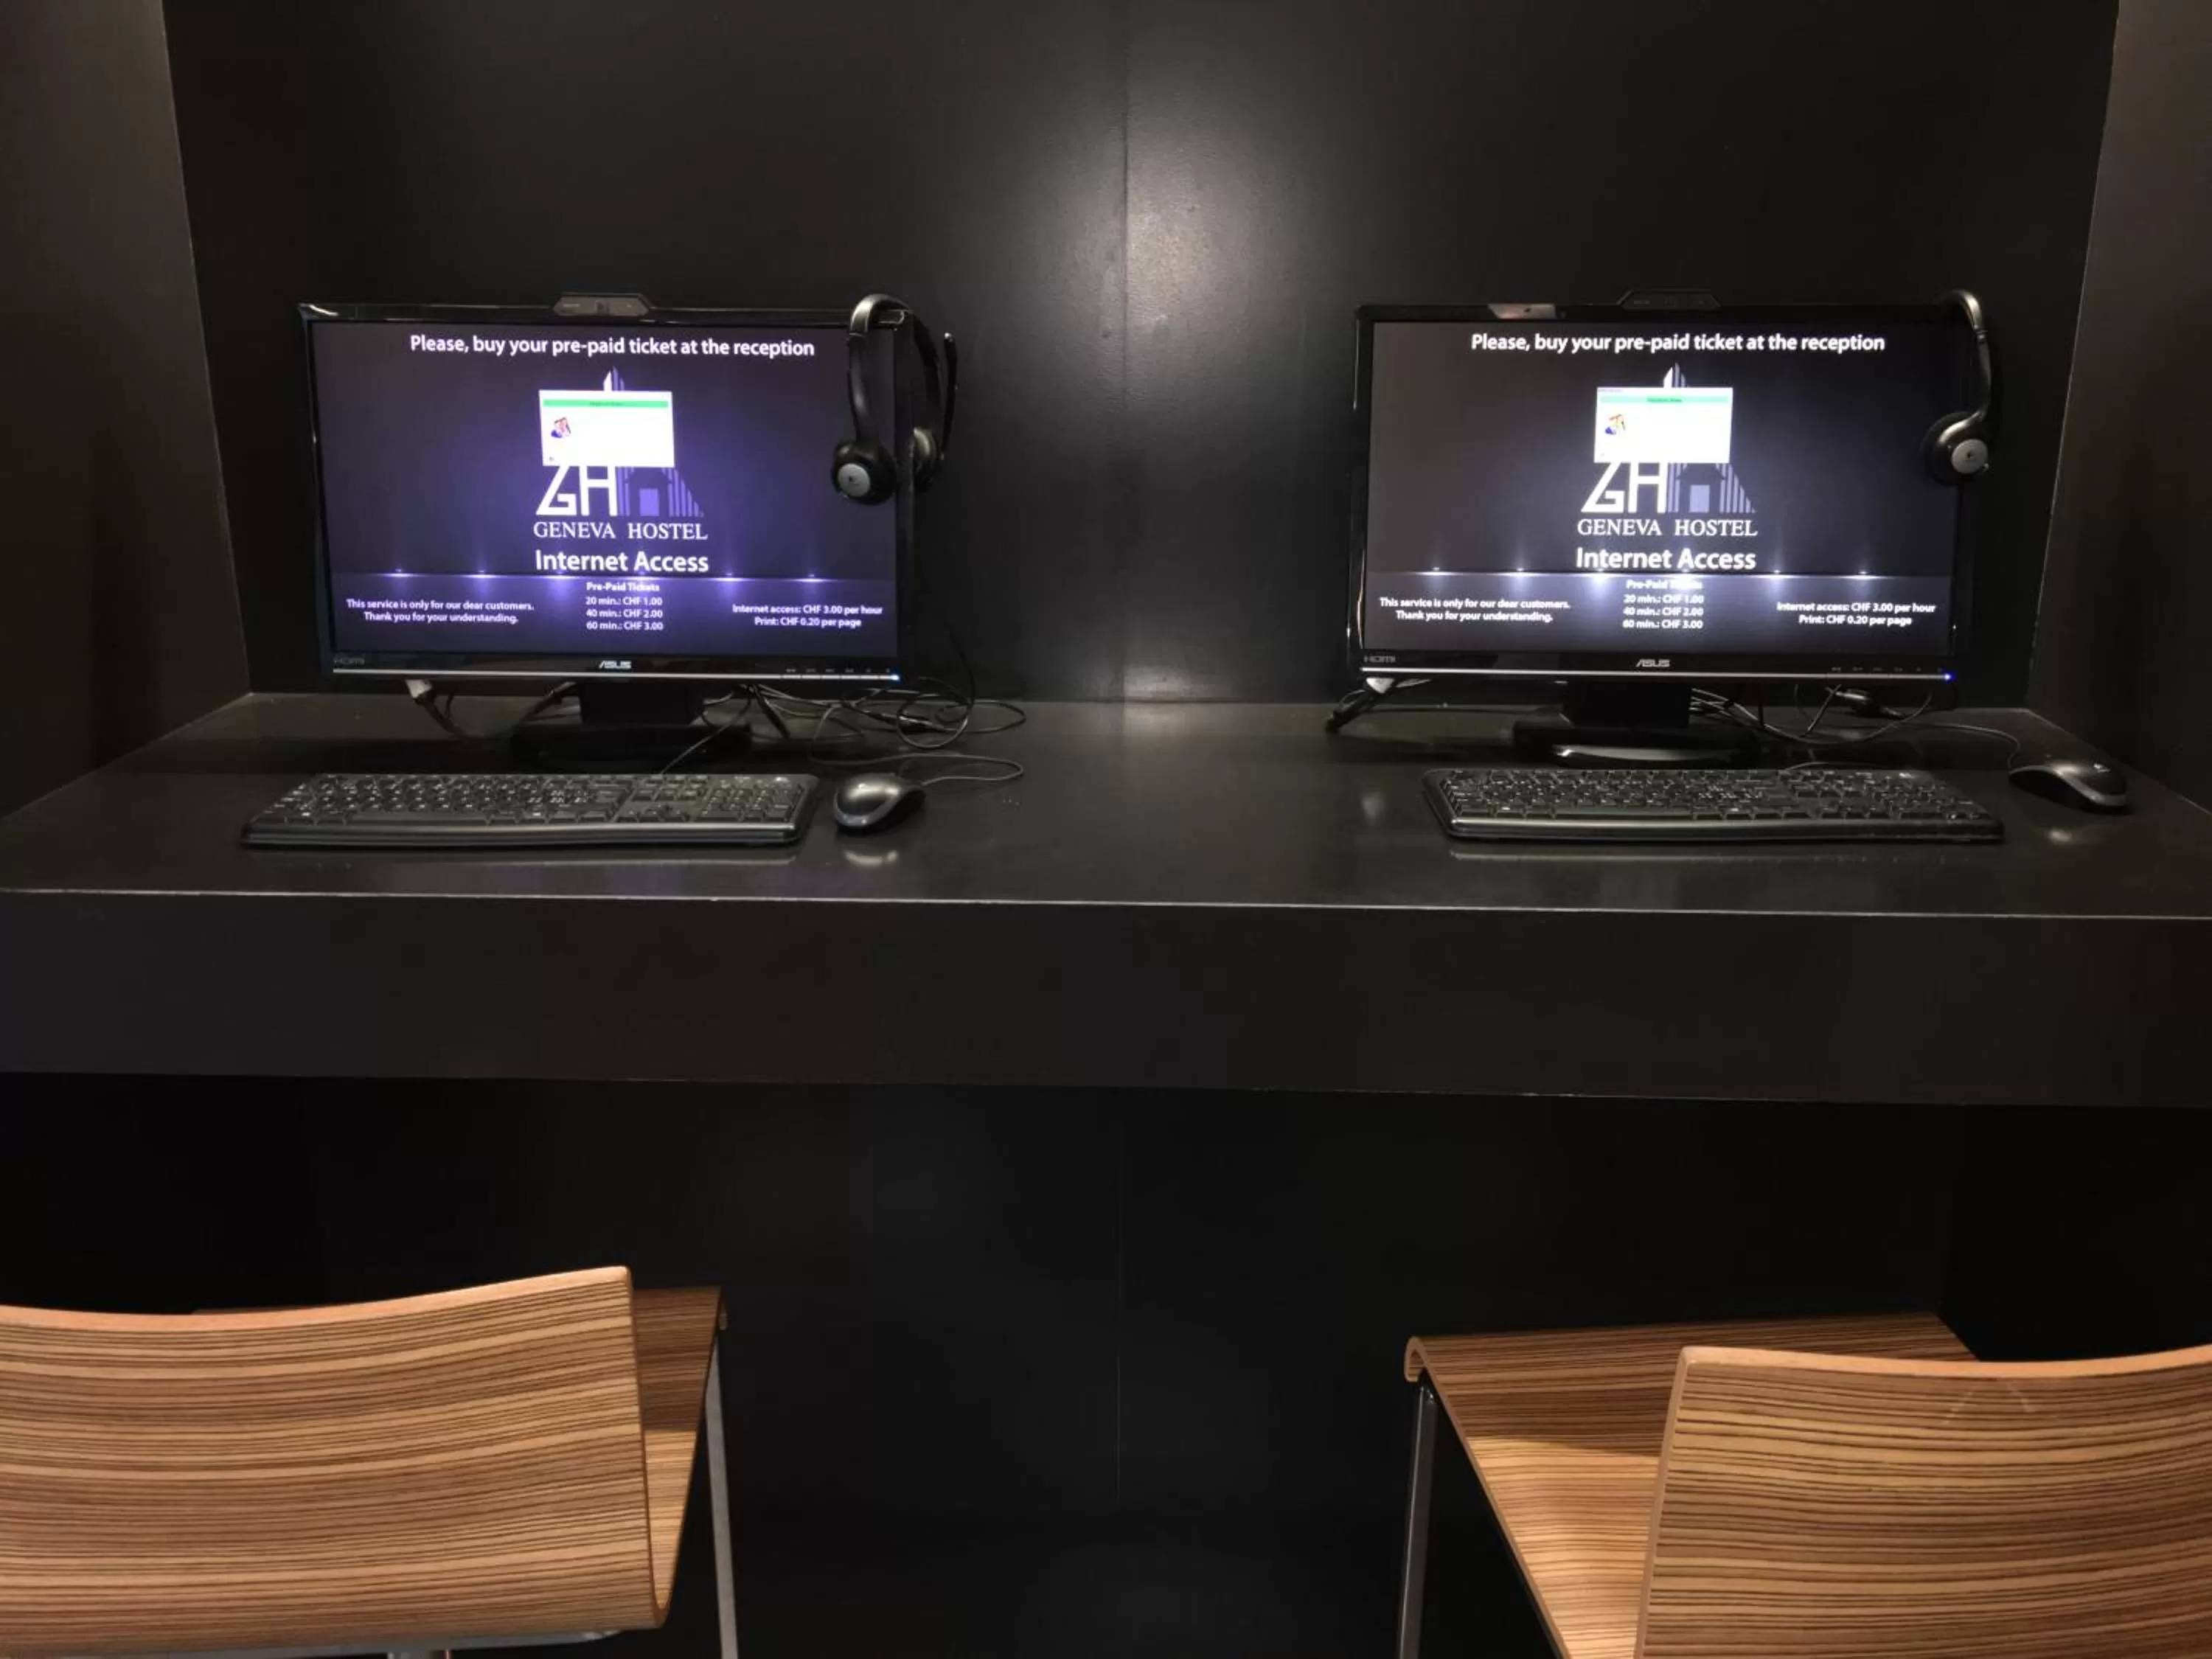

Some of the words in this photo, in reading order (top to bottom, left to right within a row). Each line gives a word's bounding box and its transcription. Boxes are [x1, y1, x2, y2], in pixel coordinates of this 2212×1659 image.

[411, 335, 470, 353] Please,
[473, 335, 505, 356] buy
[509, 339, 548, 356] your
[552, 337, 625, 358] pre-paid
[629, 337, 677, 354] ticket
[681, 339, 698, 354] at
[701, 338, 729, 355] the
[734, 339, 815, 359] reception
[1471, 333, 1530, 352] Please,
[1534, 333, 1567, 354] buy
[1571, 337, 1612, 354] your
[1614, 333, 1690, 354] pre-paid
[1694, 333, 1743, 350] ticket
[1746, 335, 1764, 350] at
[1768, 333, 1798, 350] the
[1801, 335, 1885, 354] reception
[533, 521, 616, 539] GENEVA
[628, 523, 708, 540] HOSTEL
[1577, 518, 1662, 536] GENEVA
[1674, 519, 1758, 536] HOSTEL
[535, 549, 628, 571] Internet
[633, 551, 709, 572] Access
[1576, 547, 1672, 568] Internet
[1677, 549, 1756, 569] Access
[586, 582, 626, 591] Pre-Paid
[347, 599, 365, 608] This
[367, 599, 398, 609] service
[400, 599, 407, 609] is
[409, 599, 428, 611] only
[431, 600, 443, 609] for
[463, 600, 484, 610] dear
[485, 602, 535, 611] customers.
[585, 597, 597, 605] 20
[623, 597, 642, 605] CHF
[644, 597, 663, 605] 1.00
[1380, 597, 1398, 607] This
[1400, 598, 1432, 608] service
[1433, 598, 1441, 608] is
[1443, 598, 1463, 609] only
[1464, 599, 1478, 608] for
[1498, 599, 1519, 608] dear
[1520, 600, 1571, 609] customers.
[1624, 594, 1635, 603] 20
[1663, 595, 1681, 604] CHF
[1684, 595, 1704, 604] 1.00
[733, 604, 768, 613] Internet
[771, 605, 801, 613] access:
[803, 605, 821, 613] CHF
[823, 605, 842, 614] 3.00
[844, 607, 859, 616] per
[860, 605, 883, 614] hour
[1624, 608, 1635, 616] 40
[1662, 608, 1681, 616] CHF
[1683, 608, 1704, 617] 2.00
[1777, 602, 1815, 611] Internet
[1817, 603, 1849, 612] access:
[1851, 603, 1871, 612] CHF
[1873, 603, 1893, 612] 3.00
[1894, 605, 1911, 614] per
[1913, 603, 1935, 613] hour
[364, 611, 392, 621] Thank
[393, 613, 411, 623] you
[412, 612, 425, 622] for
[427, 614, 448, 624] your
[450, 613, 518, 625] understanding.
[586, 610, 598, 618] 40
[624, 610, 642, 619] CHF
[643, 610, 663, 619] 2.00
[1397, 610, 1425, 619] Thank
[1425, 612, 1443, 622] you
[1444, 611, 1458, 620] for
[1459, 613, 1481, 622] your
[586, 622, 598, 630] 60
[624, 622, 642, 630] CHF
[644, 622, 664, 631] 3.00
[754, 616, 779, 626] Print:
[780, 617, 799, 626] CHF
[821, 619, 836, 628] per
[838, 619, 862, 629] page
[1662, 620, 1680, 629] CHF
[1683, 621, 1703, 629] 3.00
[1799, 615, 1824, 625] Print:
[1826, 615, 1846, 625] CHF
[1847, 616, 1868, 625] 0.20
[1870, 617, 1885, 627] per
[1887, 618, 1912, 627] page
[599, 660, 632, 669] ASUS
[1636, 658, 1670, 667] ASUS
